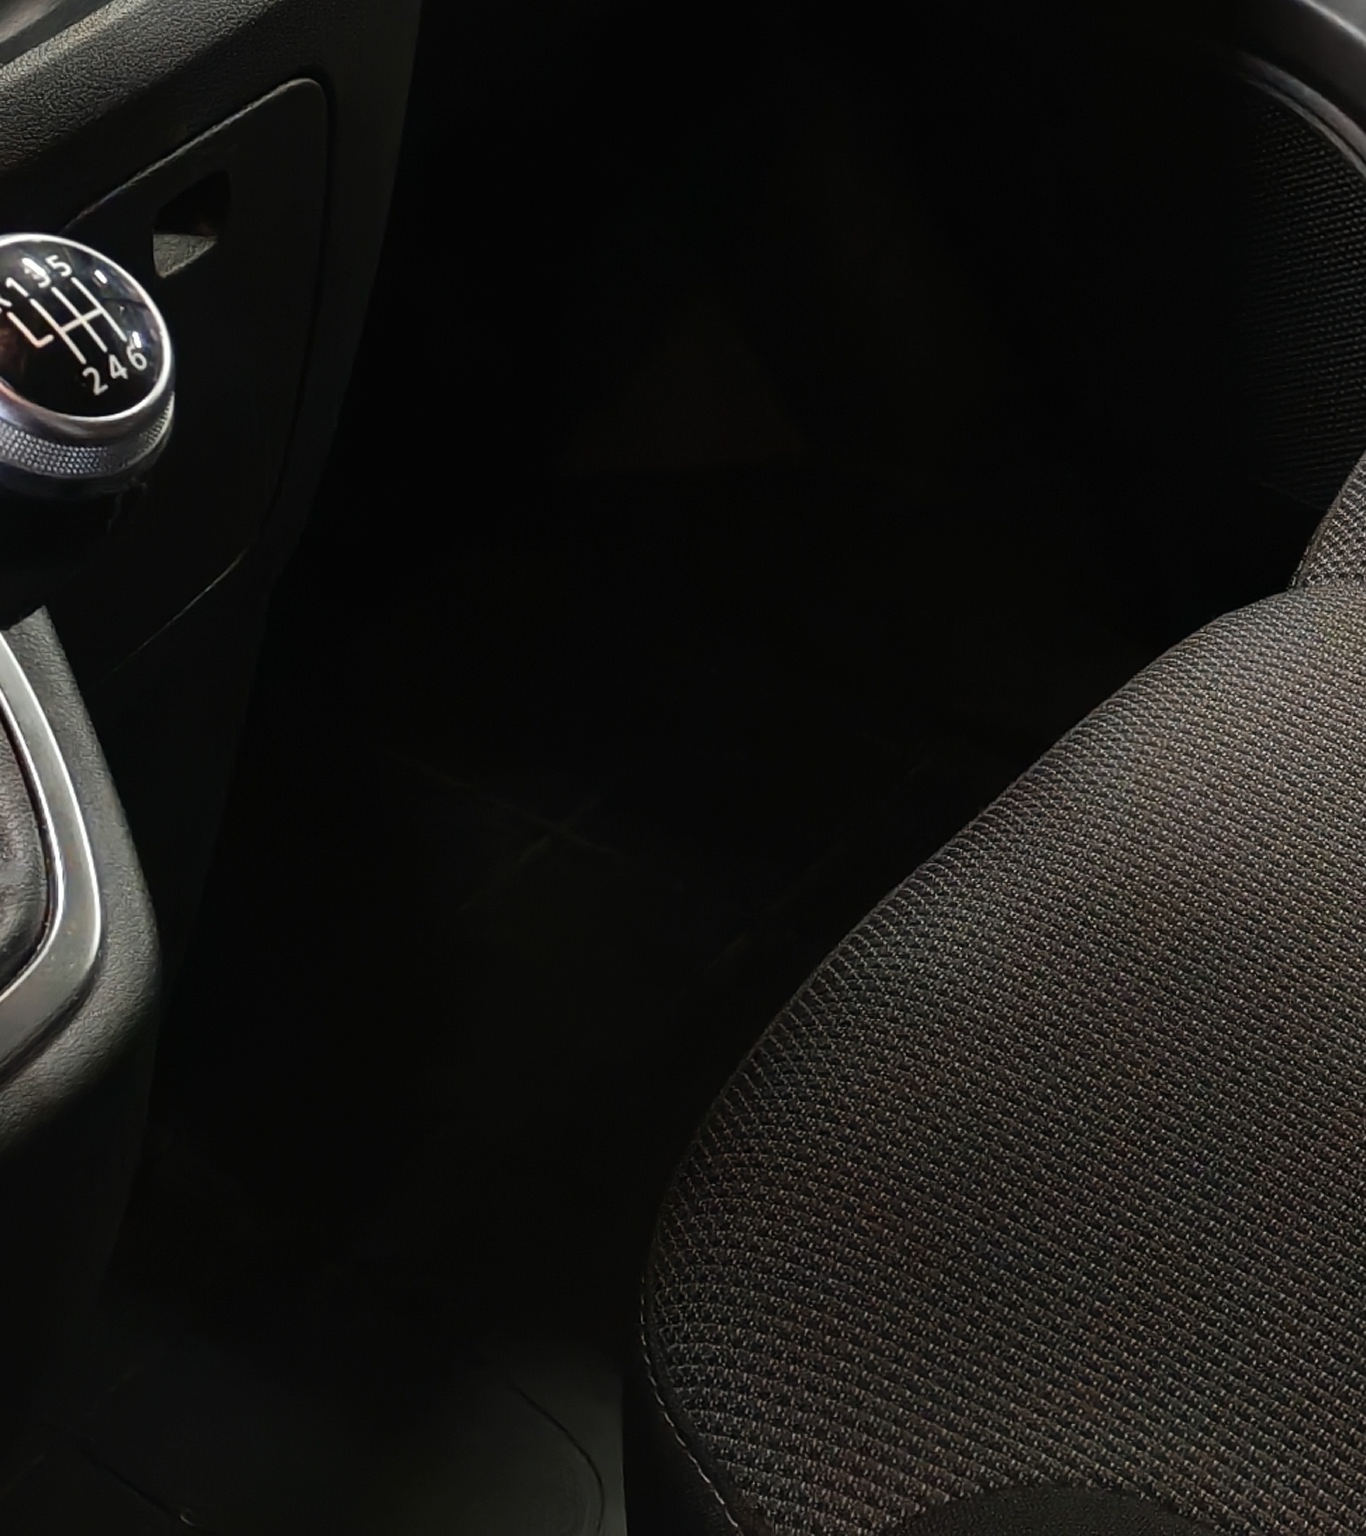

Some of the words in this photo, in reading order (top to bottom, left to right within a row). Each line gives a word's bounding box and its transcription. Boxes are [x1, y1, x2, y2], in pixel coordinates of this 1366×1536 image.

[5, 276, 30, 298] 1
[45, 255, 73, 278] 5
[82, 366, 109, 396] 2
[106, 354, 129, 381] 4
[125, 342, 148, 371] 6
